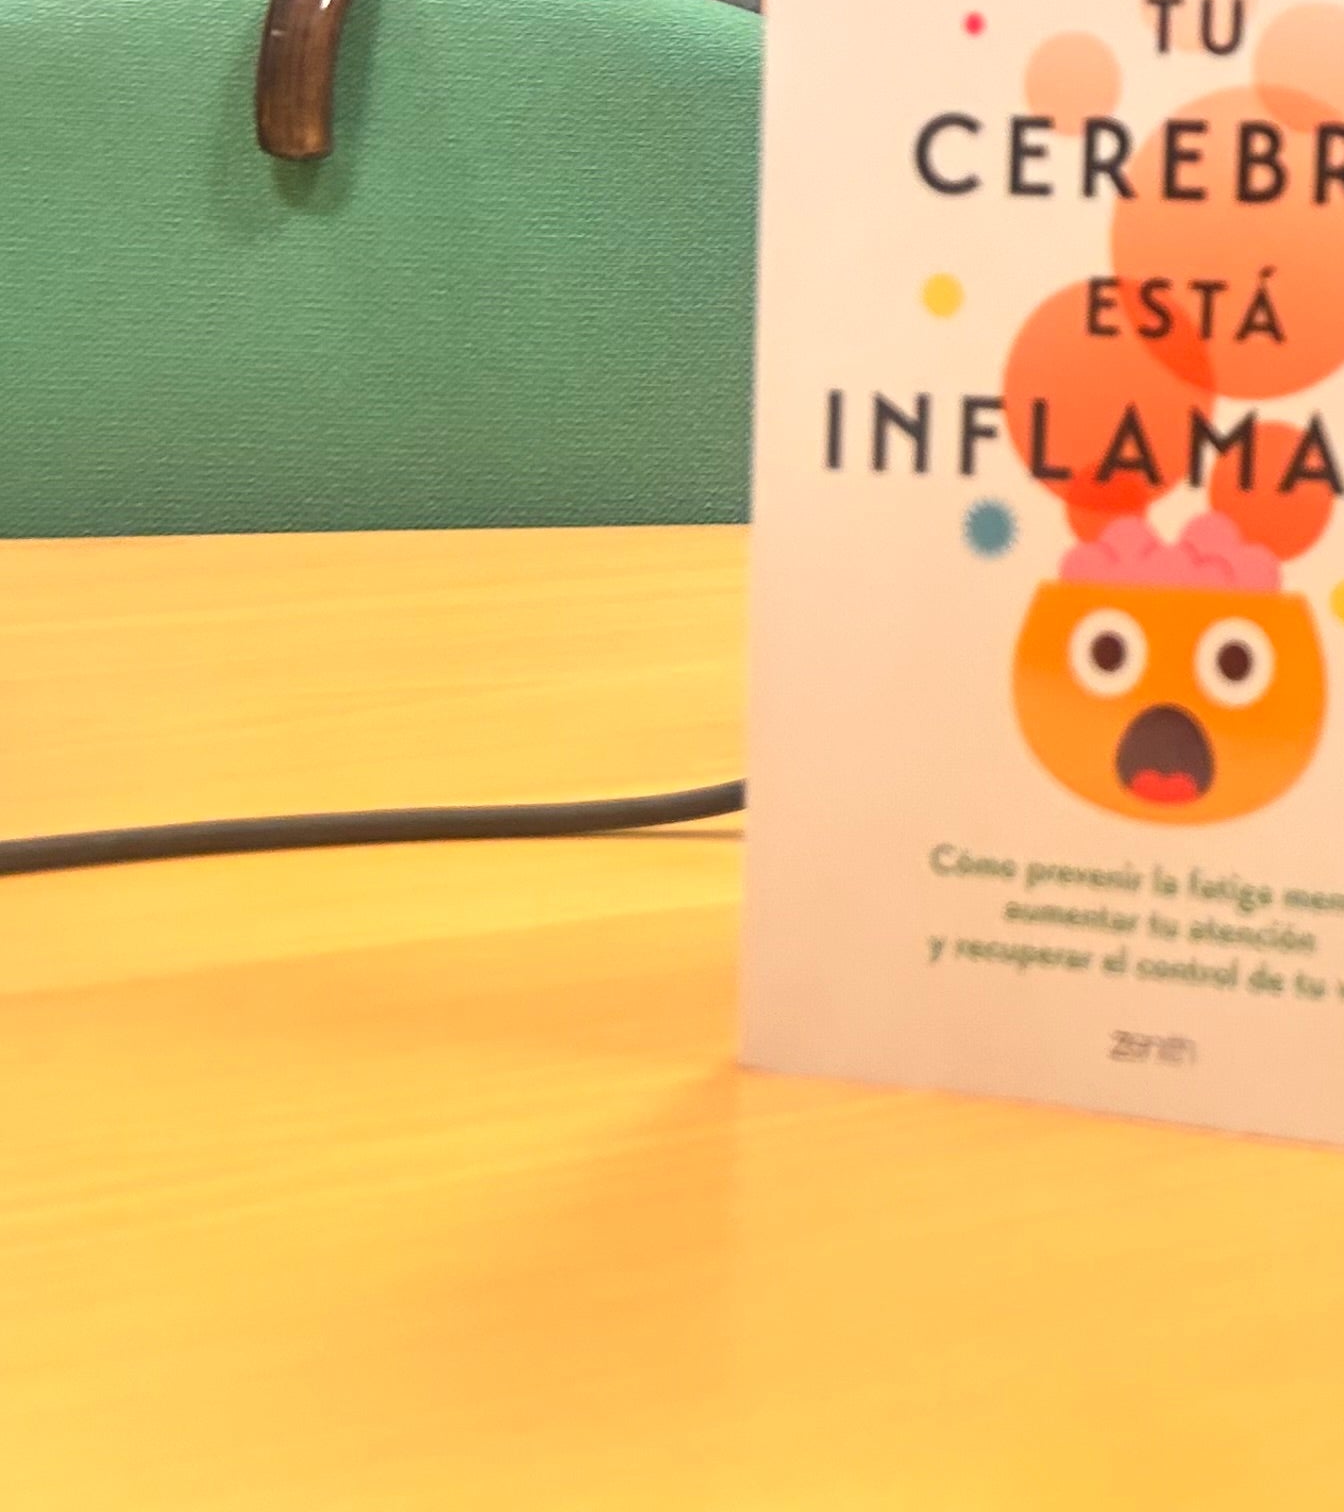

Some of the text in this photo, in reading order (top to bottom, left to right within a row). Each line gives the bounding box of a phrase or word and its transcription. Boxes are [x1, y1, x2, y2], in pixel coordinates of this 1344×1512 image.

[1086, 266, 1288, 345] ESTÁ
[928, 842, 1016, 879] Cómo
[1025, 859, 1142, 892] prevenir
[1152, 863, 1179, 895] la
[1188, 867, 1274, 912] fatiga
[1004, 899, 1317, 953] aumentar tu atención
[927, 936, 945, 964] y
[955, 938, 1092, 973] recuperar
[1101, 944, 1128, 975] el
[1136, 955, 1239, 989] control
[1247, 960, 1285, 994] de
[1294, 969, 1326, 998] tu
